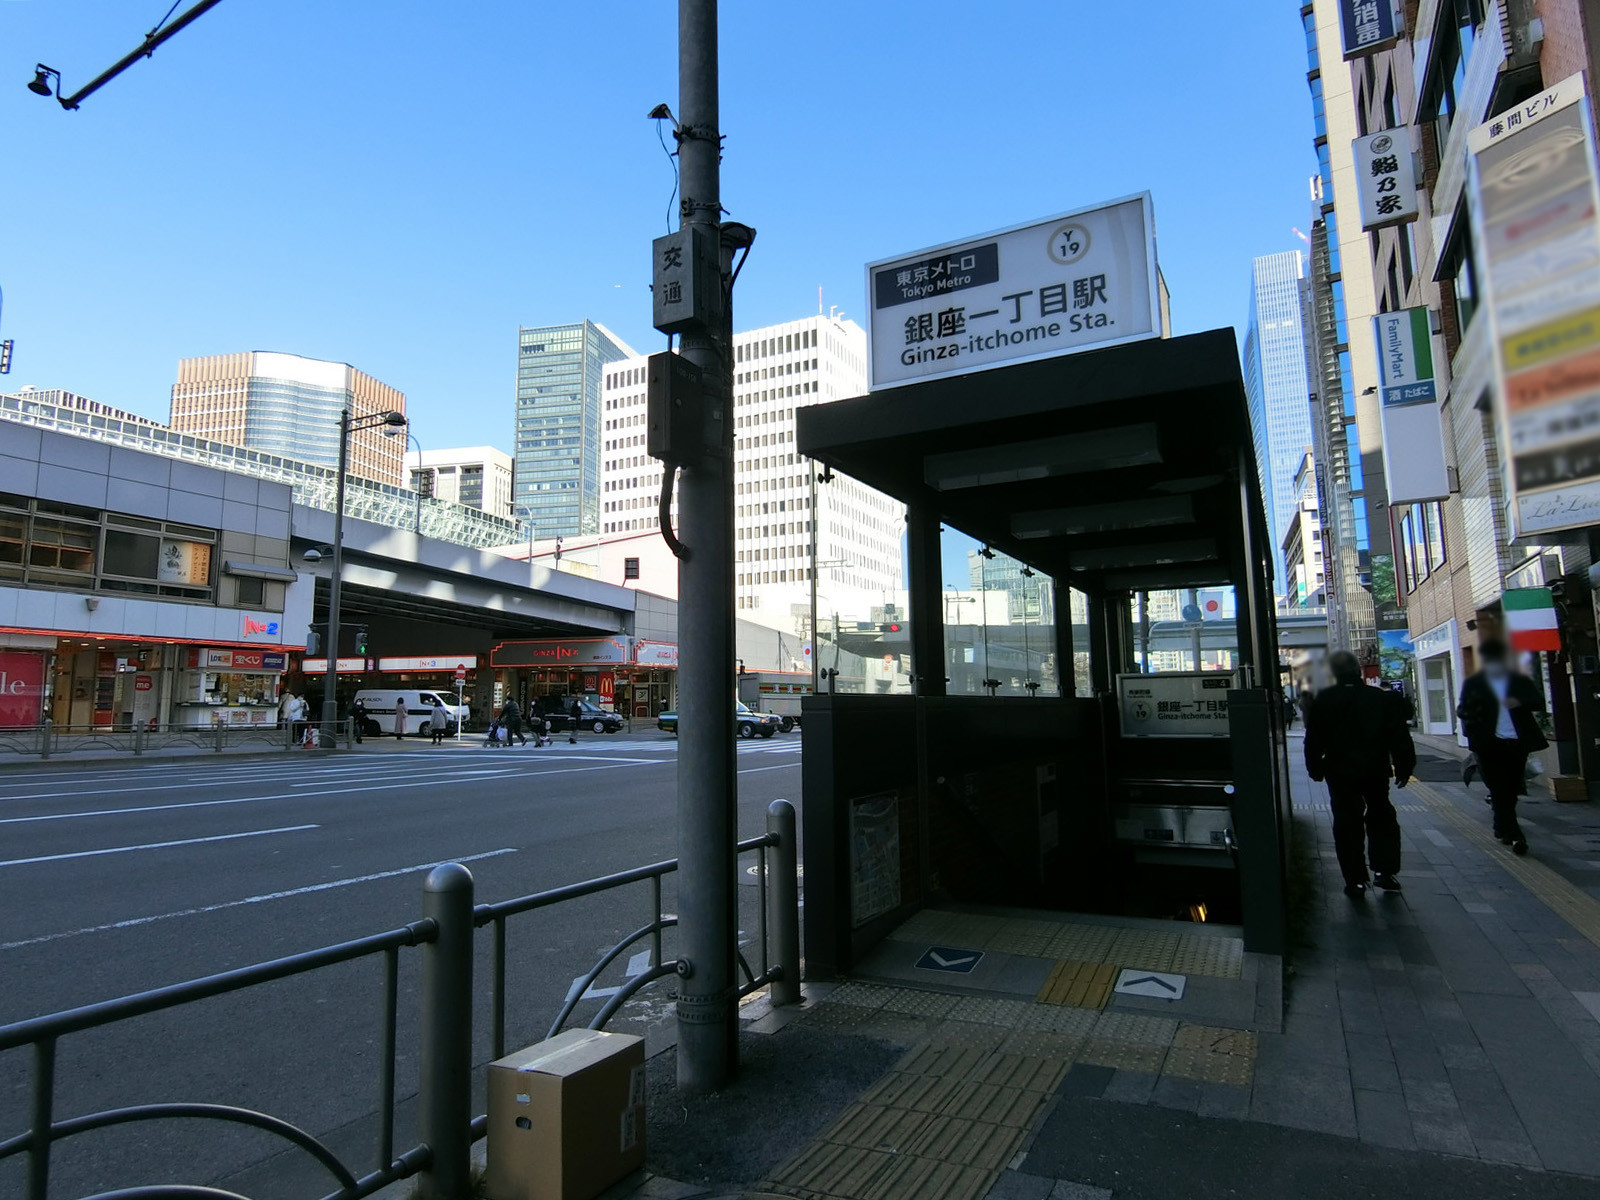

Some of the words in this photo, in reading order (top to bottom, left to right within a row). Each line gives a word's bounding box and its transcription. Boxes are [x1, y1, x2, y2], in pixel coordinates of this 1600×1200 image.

[1489, 92, 1559, 139] 藤間ビル
[1063, 230, 1073, 241] Y
[1060, 242, 1080, 257] 19
[663, 246, 683, 307] 交通
[896, 254, 976, 287] 東京メトロ
[901, 283, 934, 299] Tokyo
[936, 274, 971, 291] Metro
[904, 274, 1108, 345] 銀座一丁目駅
[901, 321, 1061, 366] Ginza-itchome
[1070, 312, 1115, 333] Sta.
[1387, 318, 1405, 380] FamilyMart
[1404, 385, 1430, 398] たばこ
[235, 655, 261, 665] 宝くじ
[1135, 710, 1147, 718] 19
[1157, 700, 1229, 713] 銀座一丁目駅
[1157, 712, 1211, 720] Ginza-itchome
